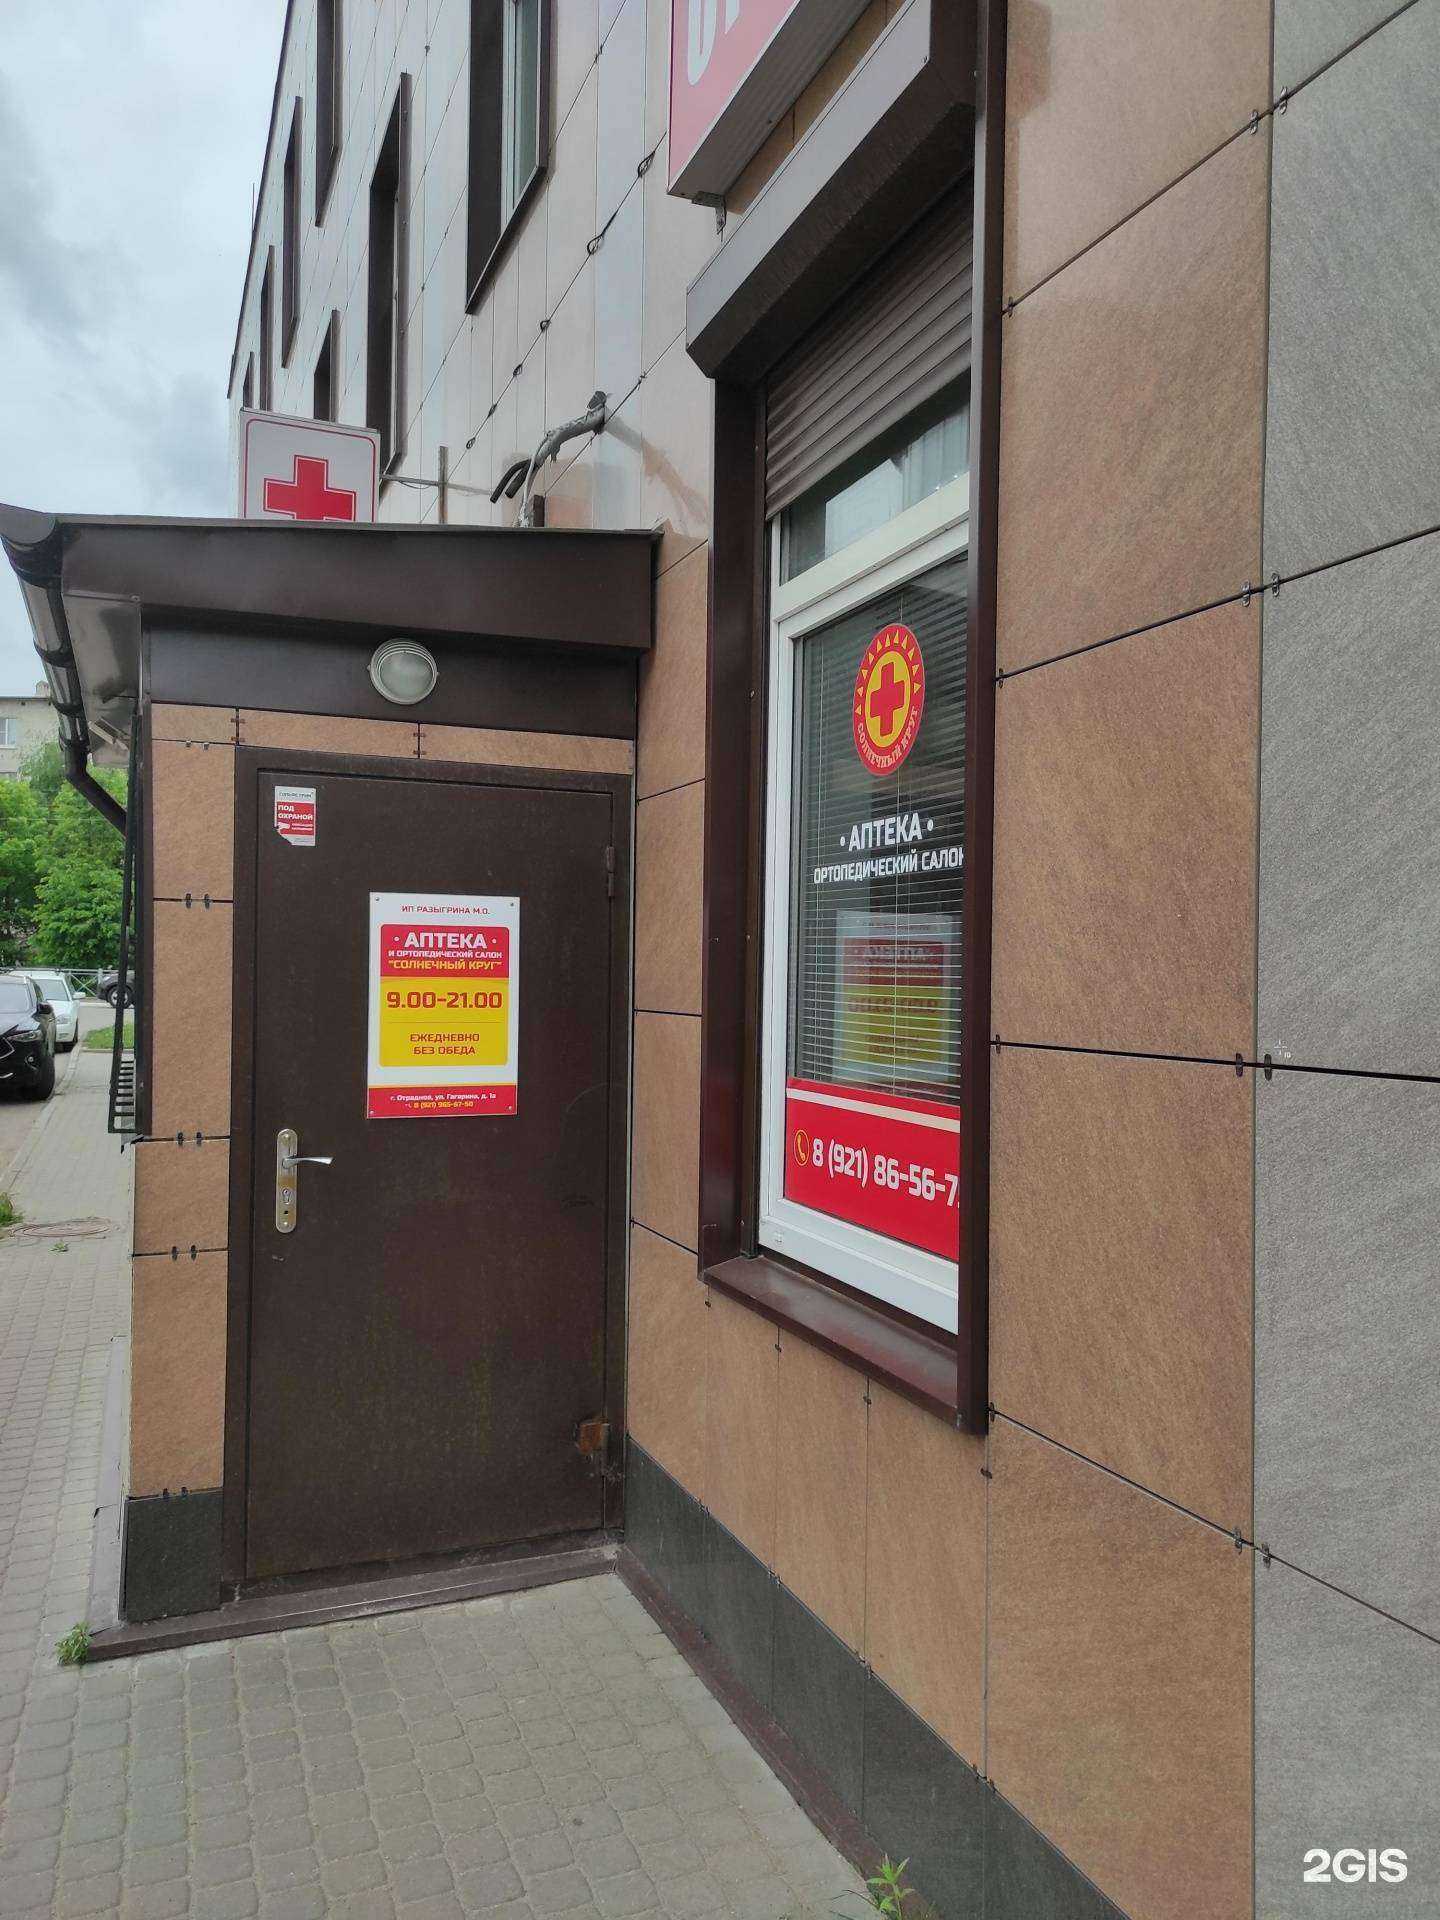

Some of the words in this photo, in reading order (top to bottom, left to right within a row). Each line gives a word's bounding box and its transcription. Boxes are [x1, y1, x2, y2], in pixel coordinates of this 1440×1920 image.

[858, 722, 902, 769] СОЛНЕЧНЫЙ
[901, 705, 918, 750] КРУГ
[277, 804, 295, 812] ПОД
[277, 813, 313, 821] ОХРАНОЙ
[848, 812, 923, 852] АПТЕКА
[813, 848, 918, 884] ОРТОПЕДИЧЕСКИЙ
[401, 905, 414, 913] ИП
[416, 905, 471, 915] РАЗЫГРИНА
[472, 907, 491, 915] М.О.
[404, 931, 488, 949] АПТЕКА
[396, 949, 474, 959] ОРТОПЕДИЧЕСКИЙ
[409, 1033, 480, 1043] ЕЖЕДНЕВНО
[413, 1046, 435, 1055] БЕЗ
[438, 1046, 476, 1055] ОБЕДА
[812, 1137, 824, 1167] 8
[828, 1138, 869, 1189] (921)
